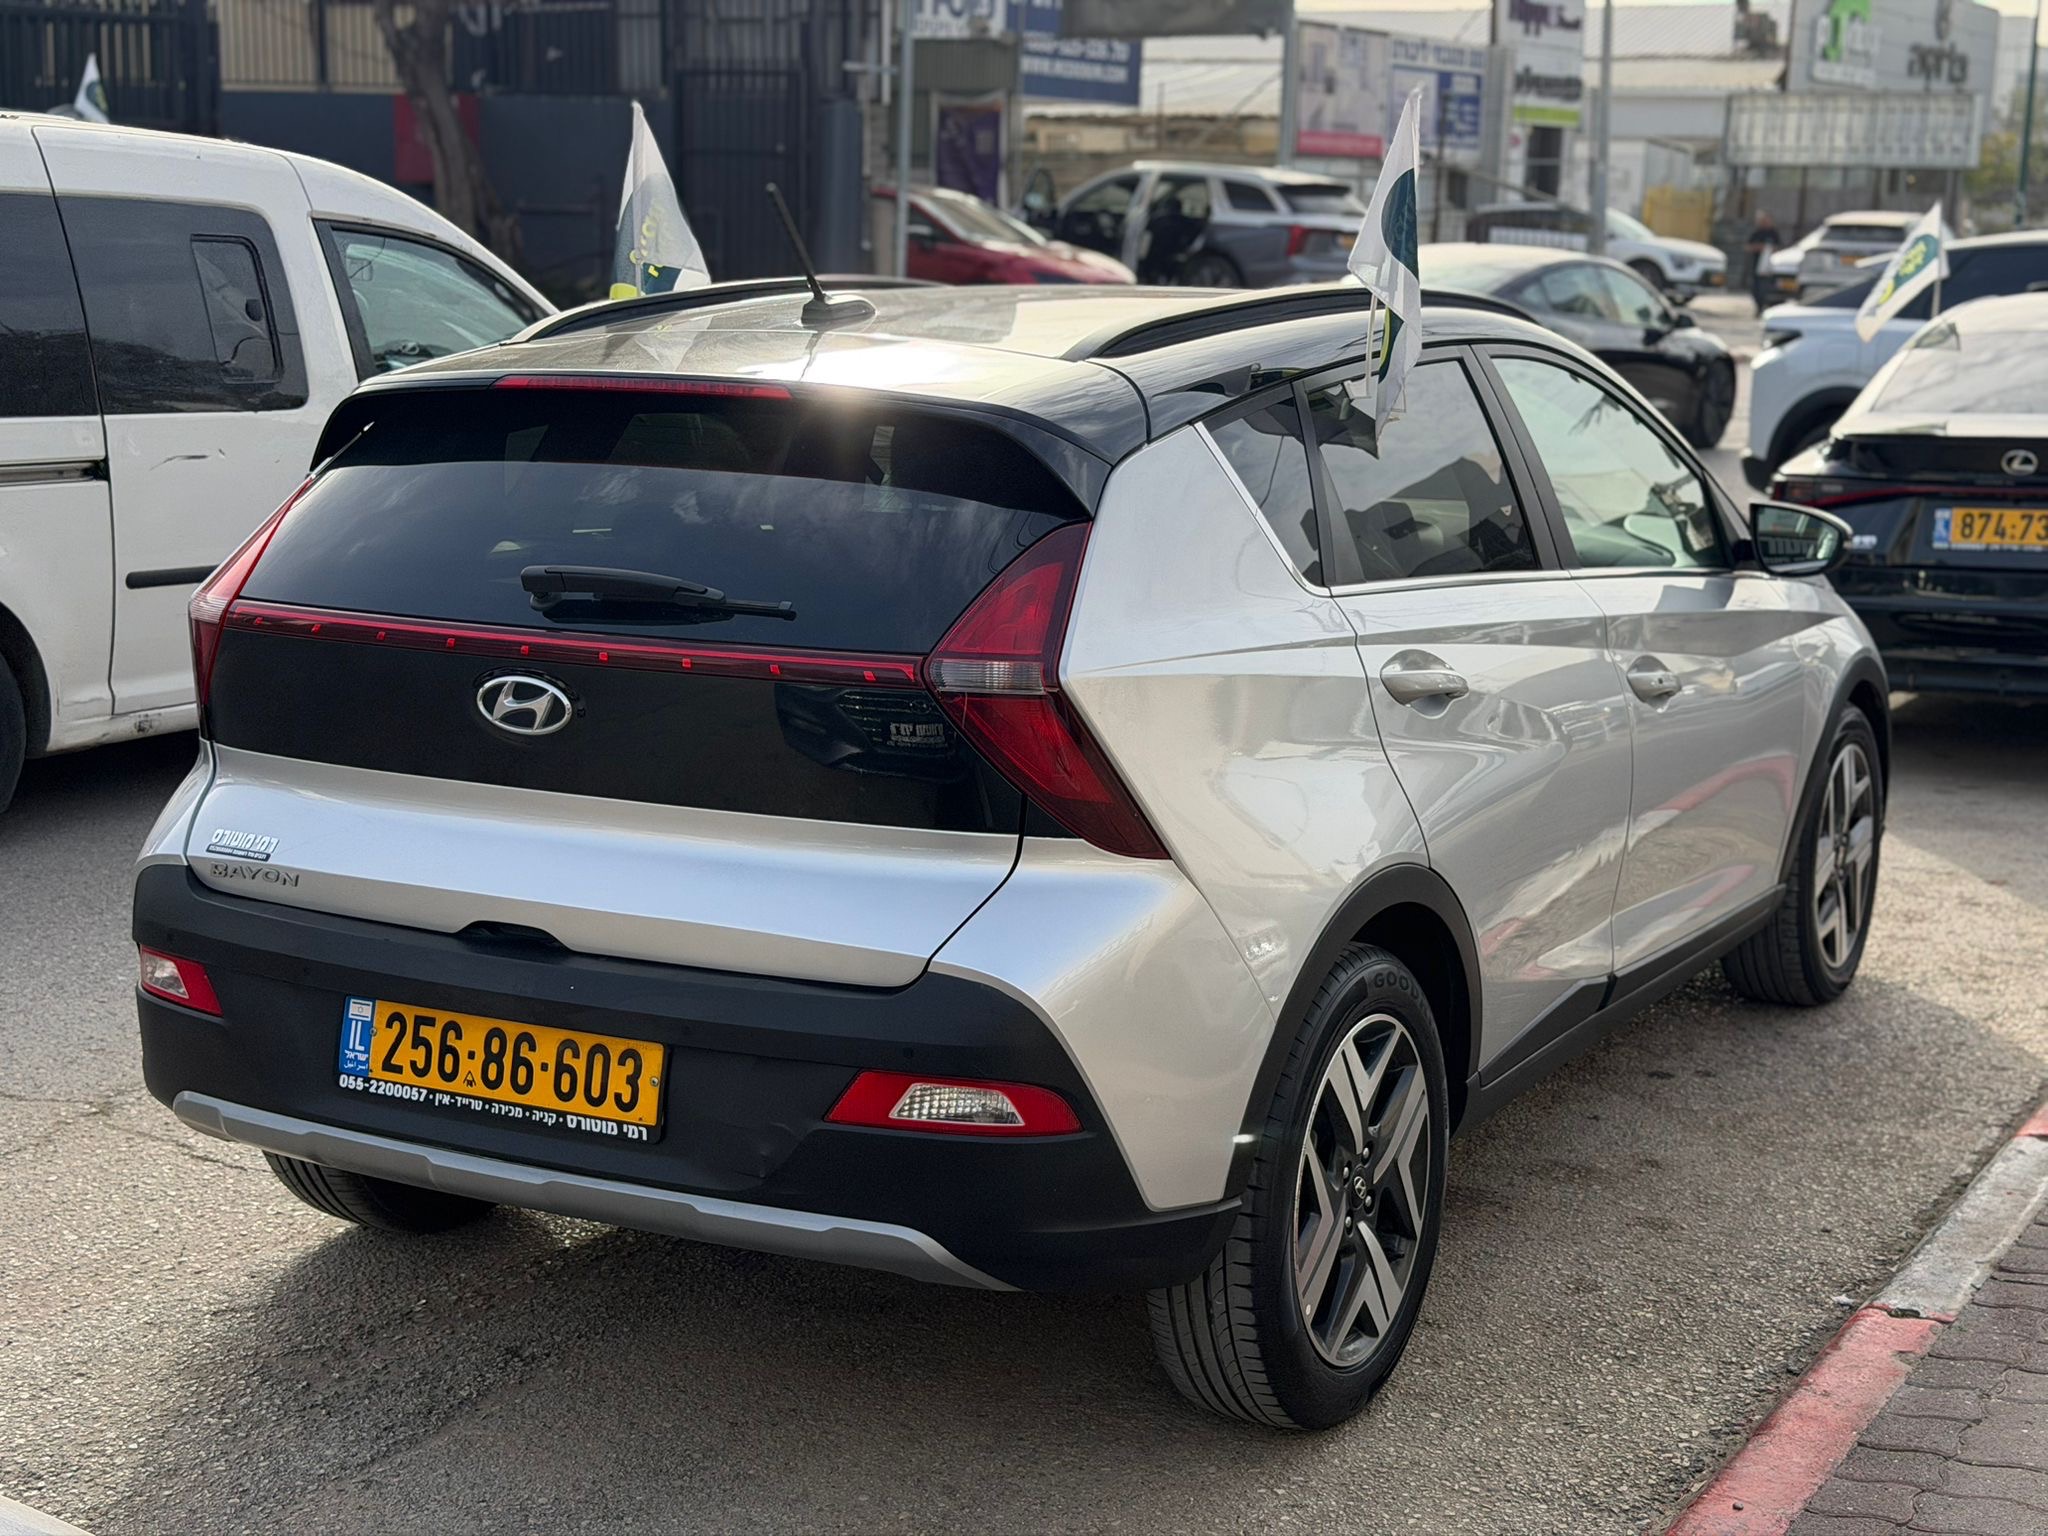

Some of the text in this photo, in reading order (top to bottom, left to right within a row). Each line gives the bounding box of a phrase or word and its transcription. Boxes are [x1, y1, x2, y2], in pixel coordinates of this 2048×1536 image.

[212, 829, 256, 850] מוטורס
[257, 834, 279, 854] רמי
[348, 1020, 365, 1051] IL
[344, 1049, 369, 1062] ישראל
[338, 1074, 649, 1142] רמי מוטורס קניה מכירה טרייד-אין 055-2200057
